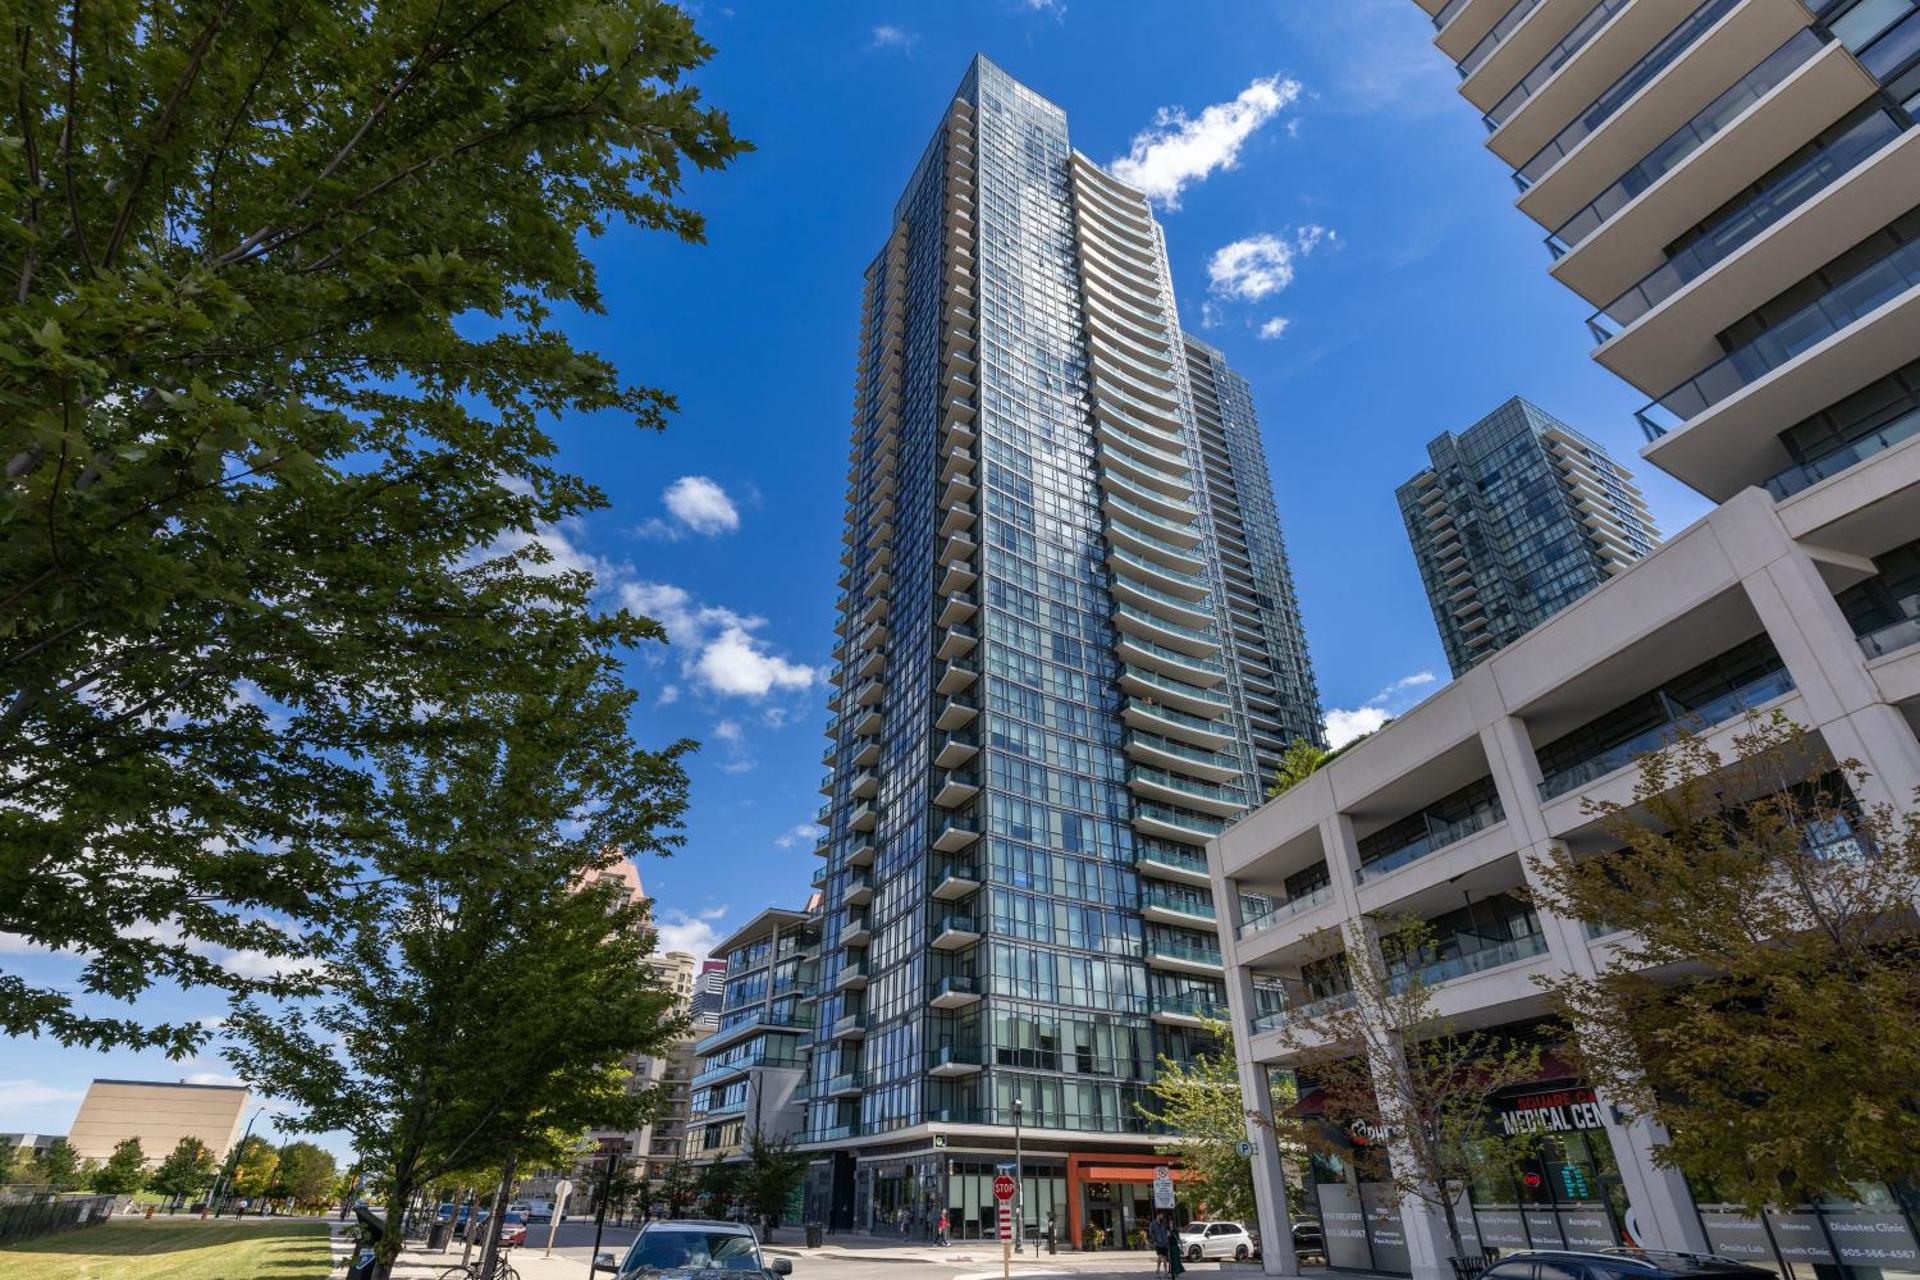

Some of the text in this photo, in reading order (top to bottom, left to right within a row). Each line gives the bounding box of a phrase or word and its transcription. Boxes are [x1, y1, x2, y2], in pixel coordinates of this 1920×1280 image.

[1517, 1093, 1571, 1110] SQUARE
[1501, 1107, 1573, 1135] MEDICAL
[995, 1183, 1014, 1193] STOP
[1568, 1218, 1602, 1228] Accepting
[1830, 1222, 1905, 1233] Diabetes Clinic
[1584, 1237, 1613, 1246] Patients
[1719, 1243, 1764, 1254] Onsite Lab
[1780, 1246, 1831, 1256] Health Clinic
[1841, 1248, 1916, 1260] 905-566-4567
